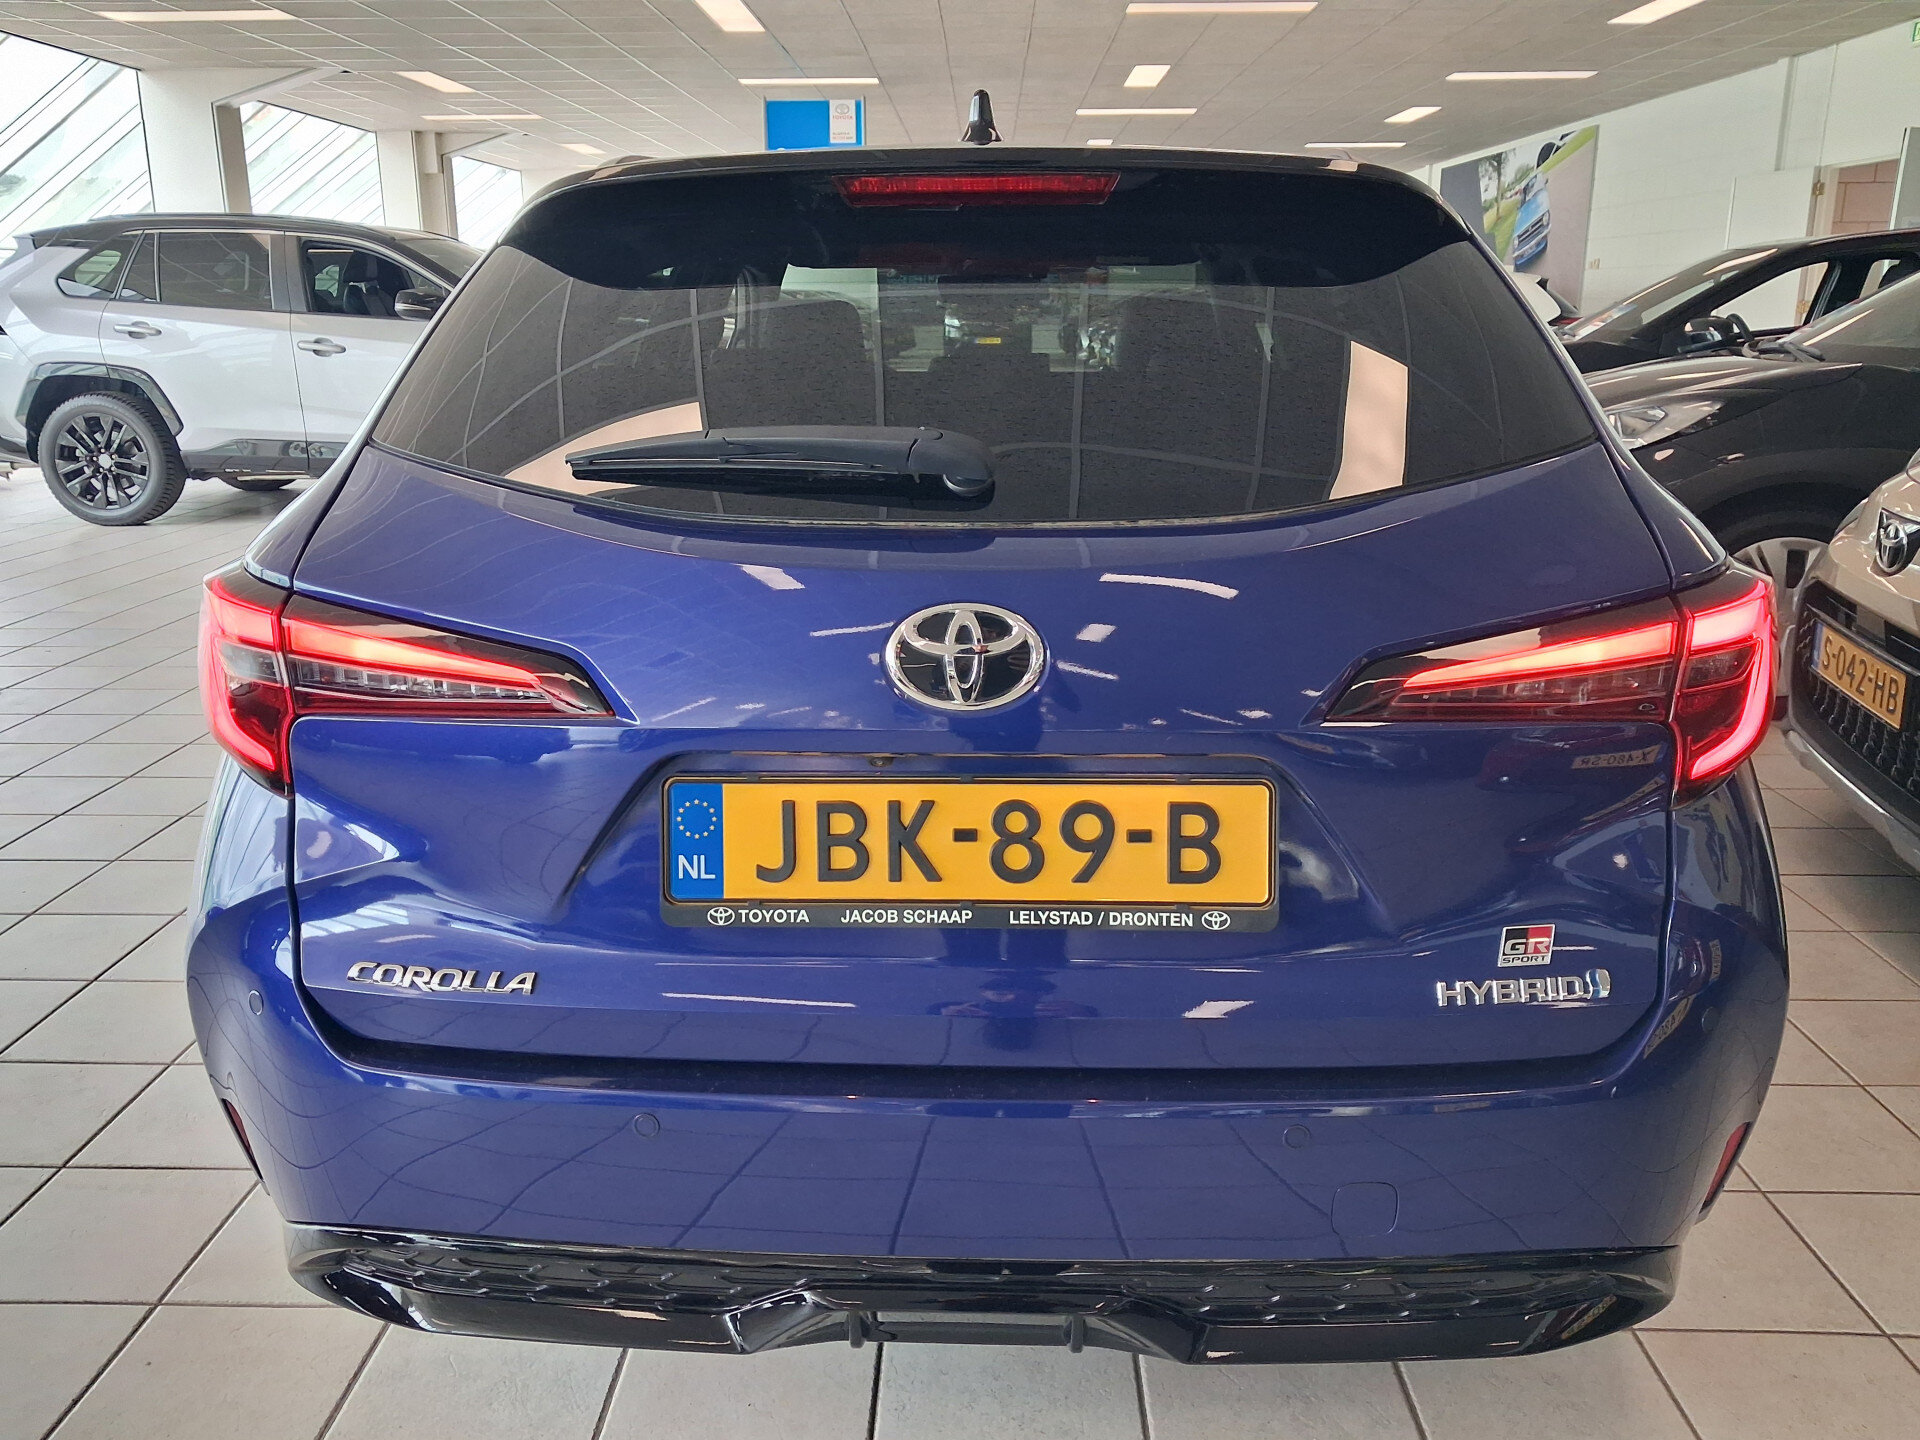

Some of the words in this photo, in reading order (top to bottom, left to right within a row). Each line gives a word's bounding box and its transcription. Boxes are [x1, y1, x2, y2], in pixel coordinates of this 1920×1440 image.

[1822, 635, 1900, 713] S-042-HB
[756, 799, 1222, 885] JBK-89-B
[678, 854, 716, 880] NL
[738, 910, 810, 924] TOYOTA
[840, 909, 898, 924] JACOB
[902, 909, 973, 925] SCHAAP
[1009, 910, 1092, 926] LELYSTAD
[1108, 912, 1194, 928] DRONTEN
[1502, 955, 1547, 964] SPORT
[1504, 937, 1549, 955] GR
[347, 961, 536, 996] COROLLA
[1436, 975, 1587, 1006] HYBRID
